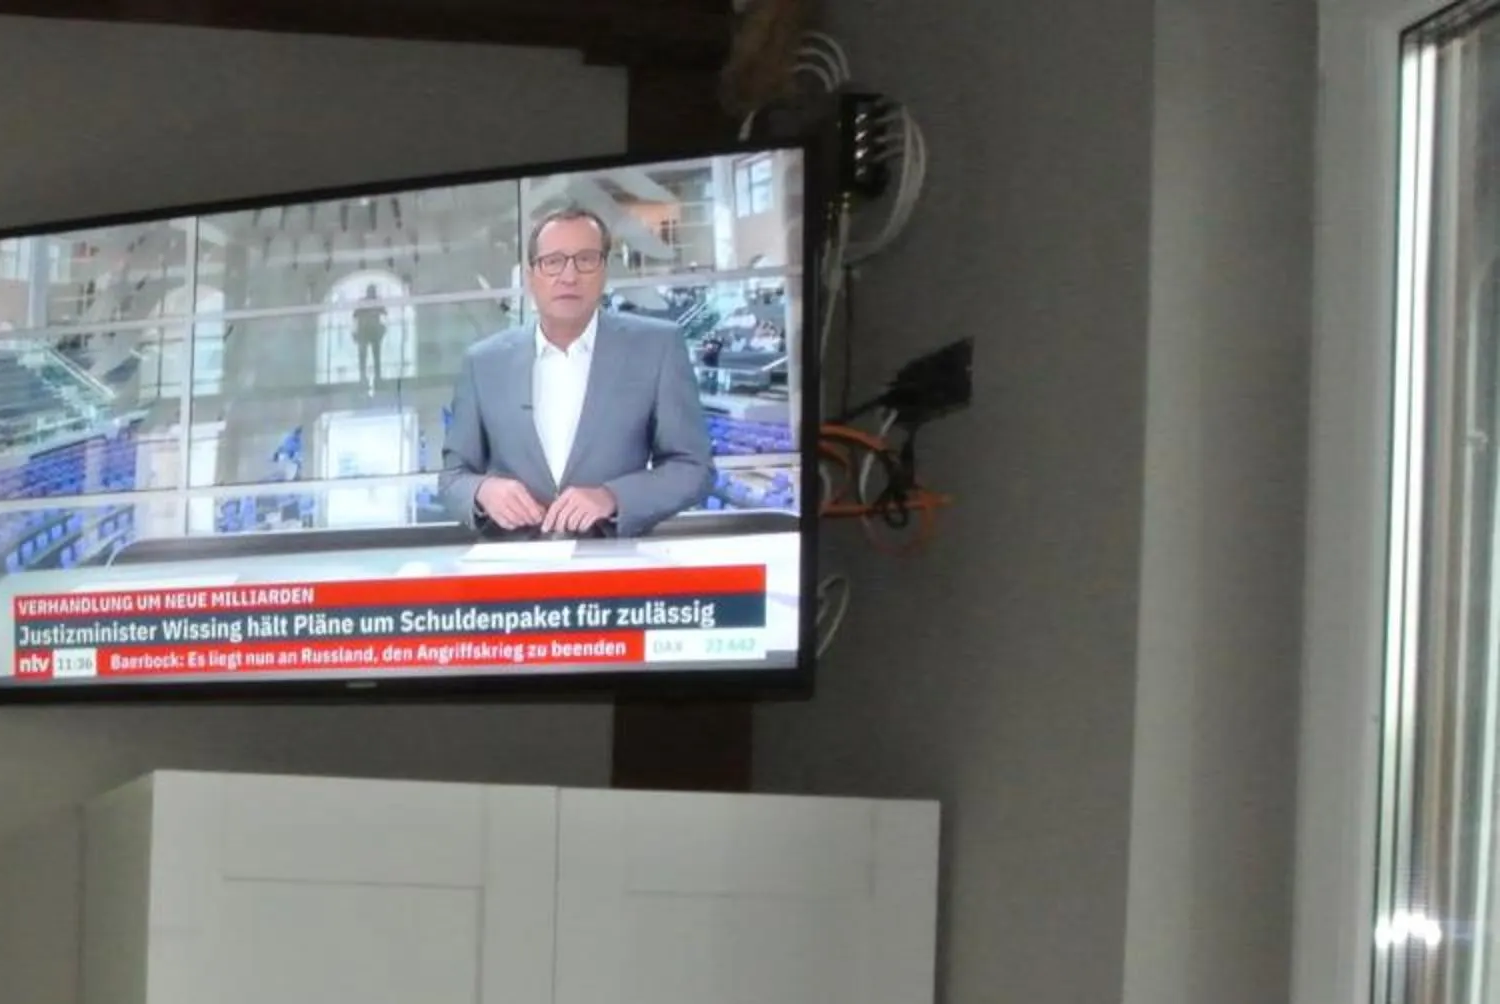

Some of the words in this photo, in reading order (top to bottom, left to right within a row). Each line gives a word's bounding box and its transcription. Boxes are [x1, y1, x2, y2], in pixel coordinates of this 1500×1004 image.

[18, 595, 133, 616] VERHANDLUNG
[137, 593, 162, 610] UM
[165, 591, 208, 609] NEUE
[211, 588, 314, 608] MILLIARDEN
[19, 621, 157, 646] Justizminister
[162, 617, 243, 643] Wissing
[247, 615, 288, 638] hält
[294, 613, 354, 635] Pläne
[360, 616, 393, 633] um
[401, 605, 571, 634] Schuldenpaket
[576, 604, 613, 628] für
[616, 599, 715, 629] zulässig
[18, 656, 50, 674] ntv
[110, 652, 184, 670] Baerbock:
[188, 652, 206, 668] Es
[209, 650, 242, 669] liegt
[245, 651, 274, 666] nun
[276, 650, 298, 665] an
[301, 646, 378, 664] Russland,
[382, 644, 413, 661] den
[416, 641, 524, 664] Angriffskrieg
[527, 644, 547, 659] zu
[551, 639, 626, 658] beenden
